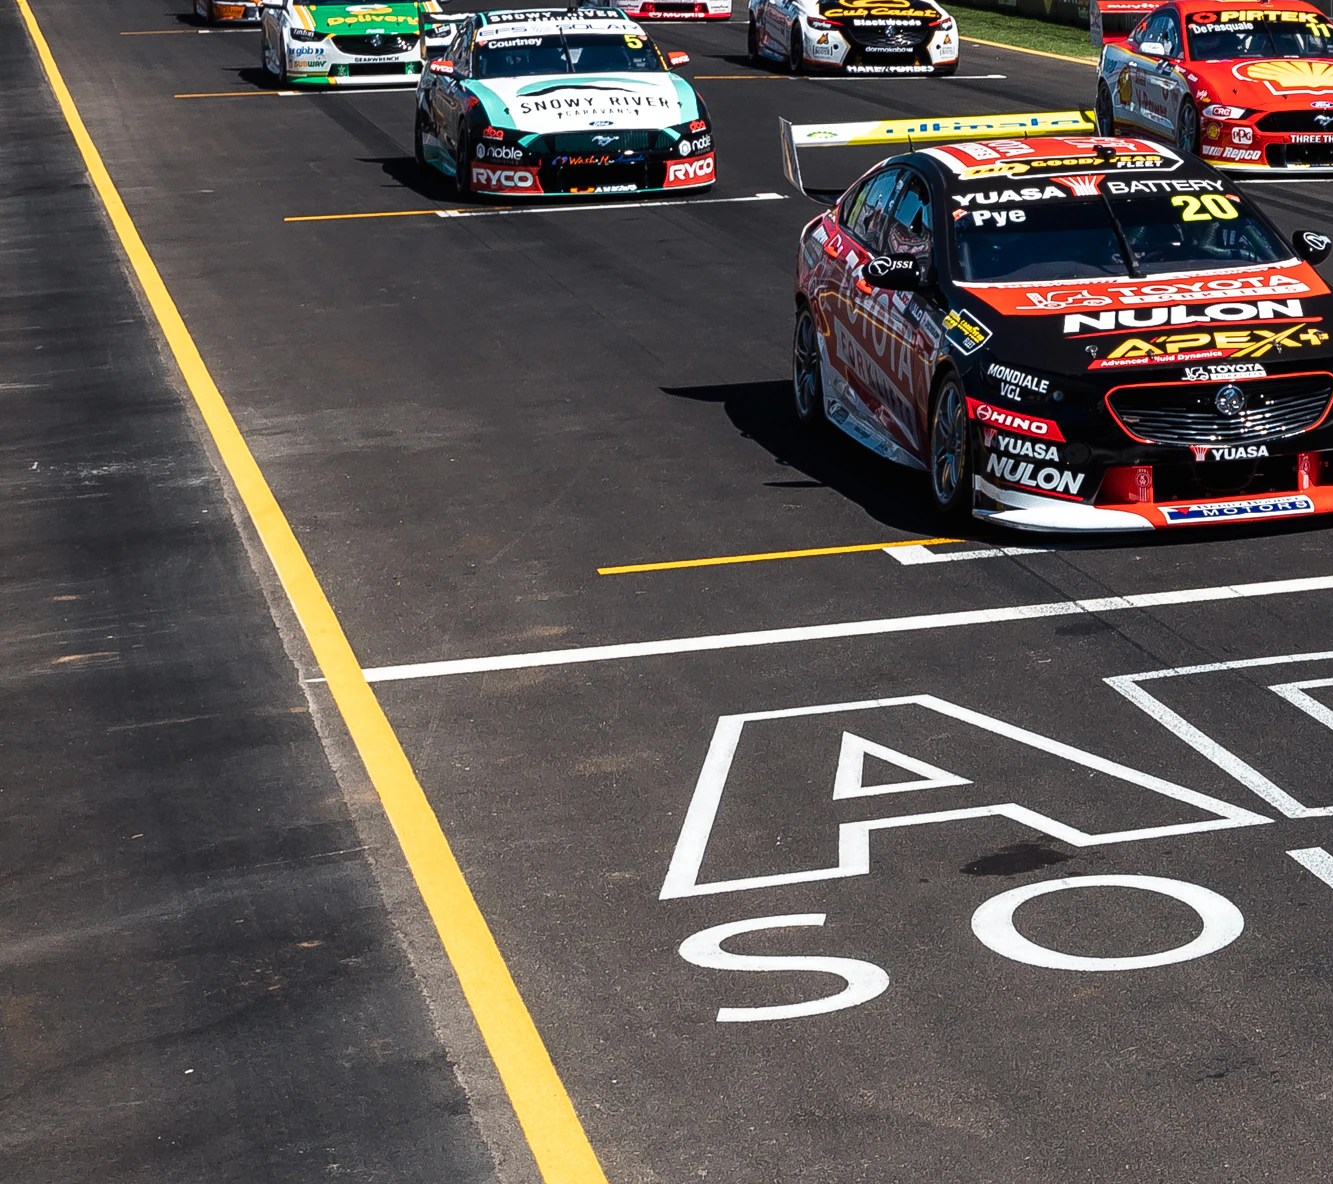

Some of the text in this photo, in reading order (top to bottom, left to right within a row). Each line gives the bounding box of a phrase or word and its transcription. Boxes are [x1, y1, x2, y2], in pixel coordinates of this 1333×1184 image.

[327, 15, 419, 26] Delivery
[824, 8, 867, 18] Cub
[1220, 10, 1319, 24] PIRTEK
[1305, 22, 1331, 38] 11
[488, 37, 543, 49] Courtney
[623, 34, 643, 49] 5
[520, 96, 670, 115] SNOWY RIVER
[692, 134, 712, 151] noble
[1232, 128, 1253, 144] PPG
[1290, 134, 1322, 144] THREE
[486, 143, 523, 161] noble
[1223, 147, 1262, 161] Repco
[668, 157, 714, 182] RYCO
[1116, 160, 1164, 169] FLEET
[472, 168, 534, 187] RYCO
[1107, 178, 1225, 195] BATTERY
[952, 185, 1067, 207] YUASA
[1170, 193, 1240, 222] 20
[971, 208, 1027, 227] Pye
[890, 259, 915, 271] JSSI
[1108, 273, 1302, 298] TOYOTA
[1063, 299, 1304, 334] NULON
[1100, 349, 1223, 367] Advanced Dynamics
[1207, 362, 1265, 374] TOYOTA
[987, 363, 1050, 394] MONDIALE
[1000, 382, 1022, 402] VGL
[990, 412, 1049, 434] HINO
[997, 435, 1060, 462] YUASA
[1211, 445, 1269, 461] YUASA
[986, 452, 1085, 495] NULON
[1202, 499, 1309, 517] MOTORS
